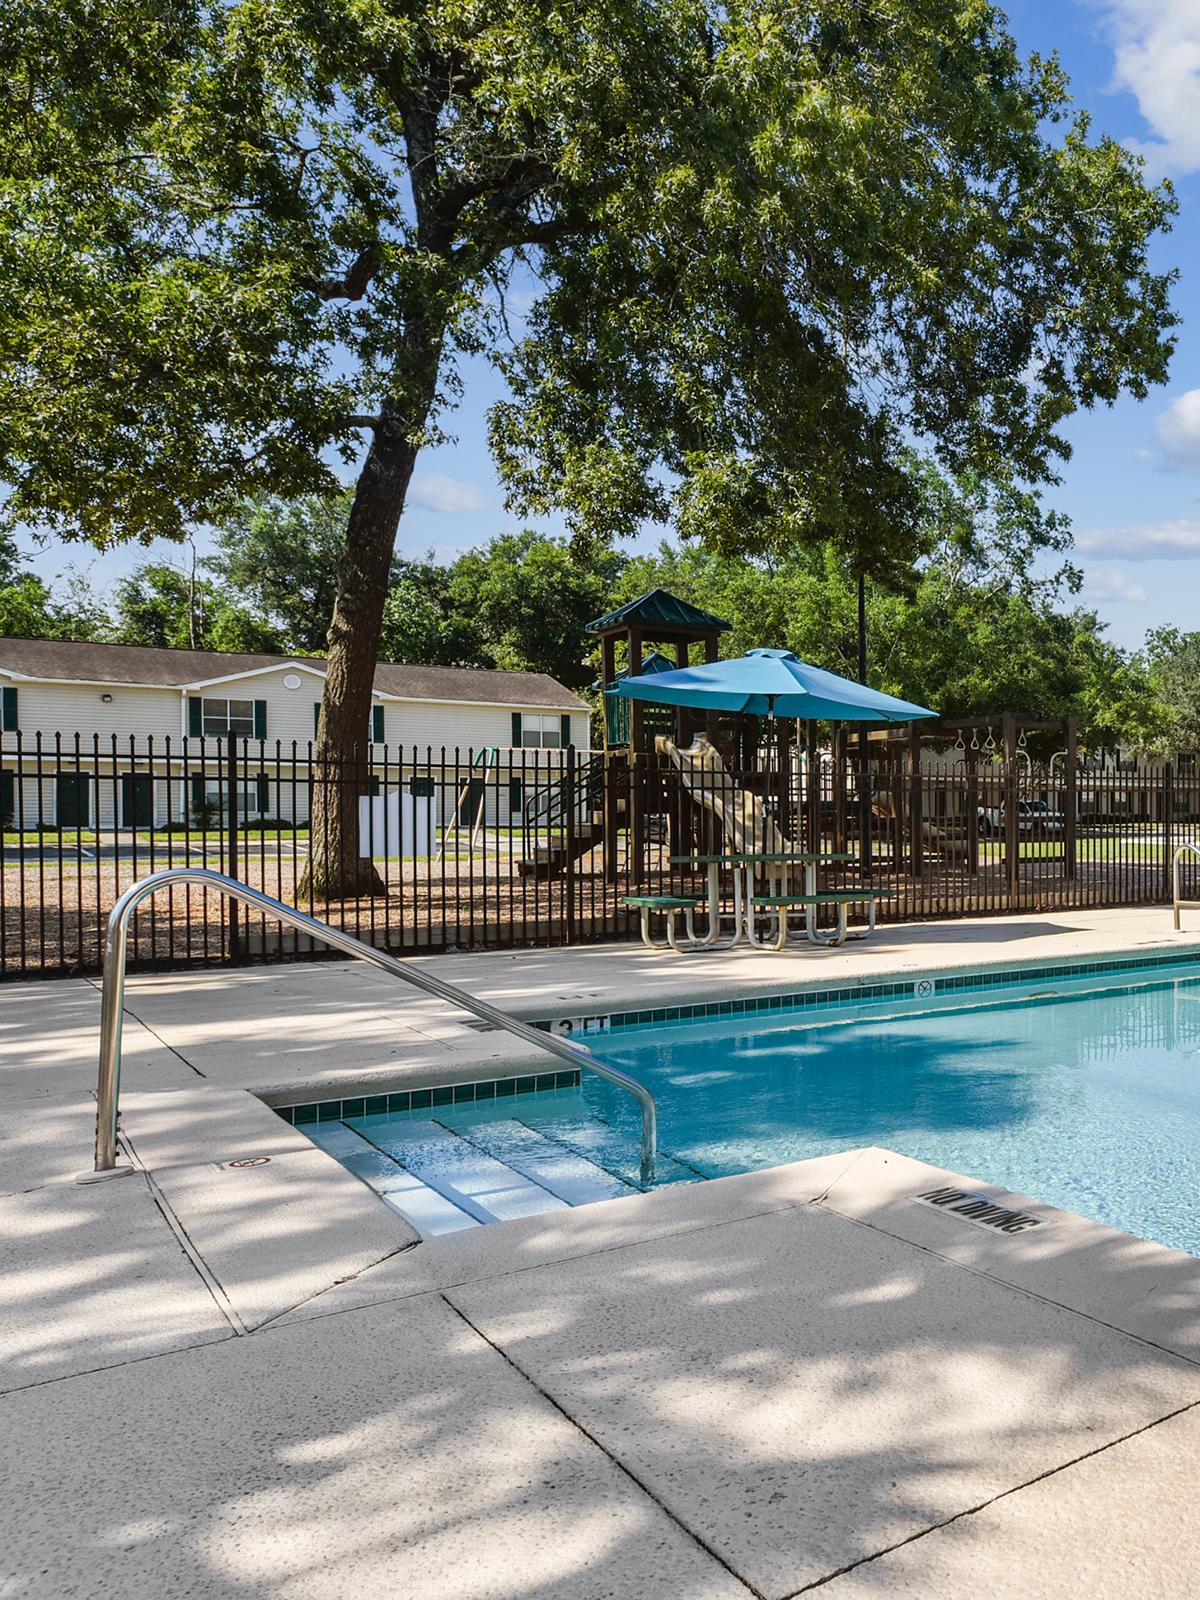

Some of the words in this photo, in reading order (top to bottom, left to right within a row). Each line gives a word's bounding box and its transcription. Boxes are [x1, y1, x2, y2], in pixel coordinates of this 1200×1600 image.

[583, 1015, 608, 1036] FT
[916, 1186, 968, 1205] NO
[946, 1200, 1043, 1234] DIVING
